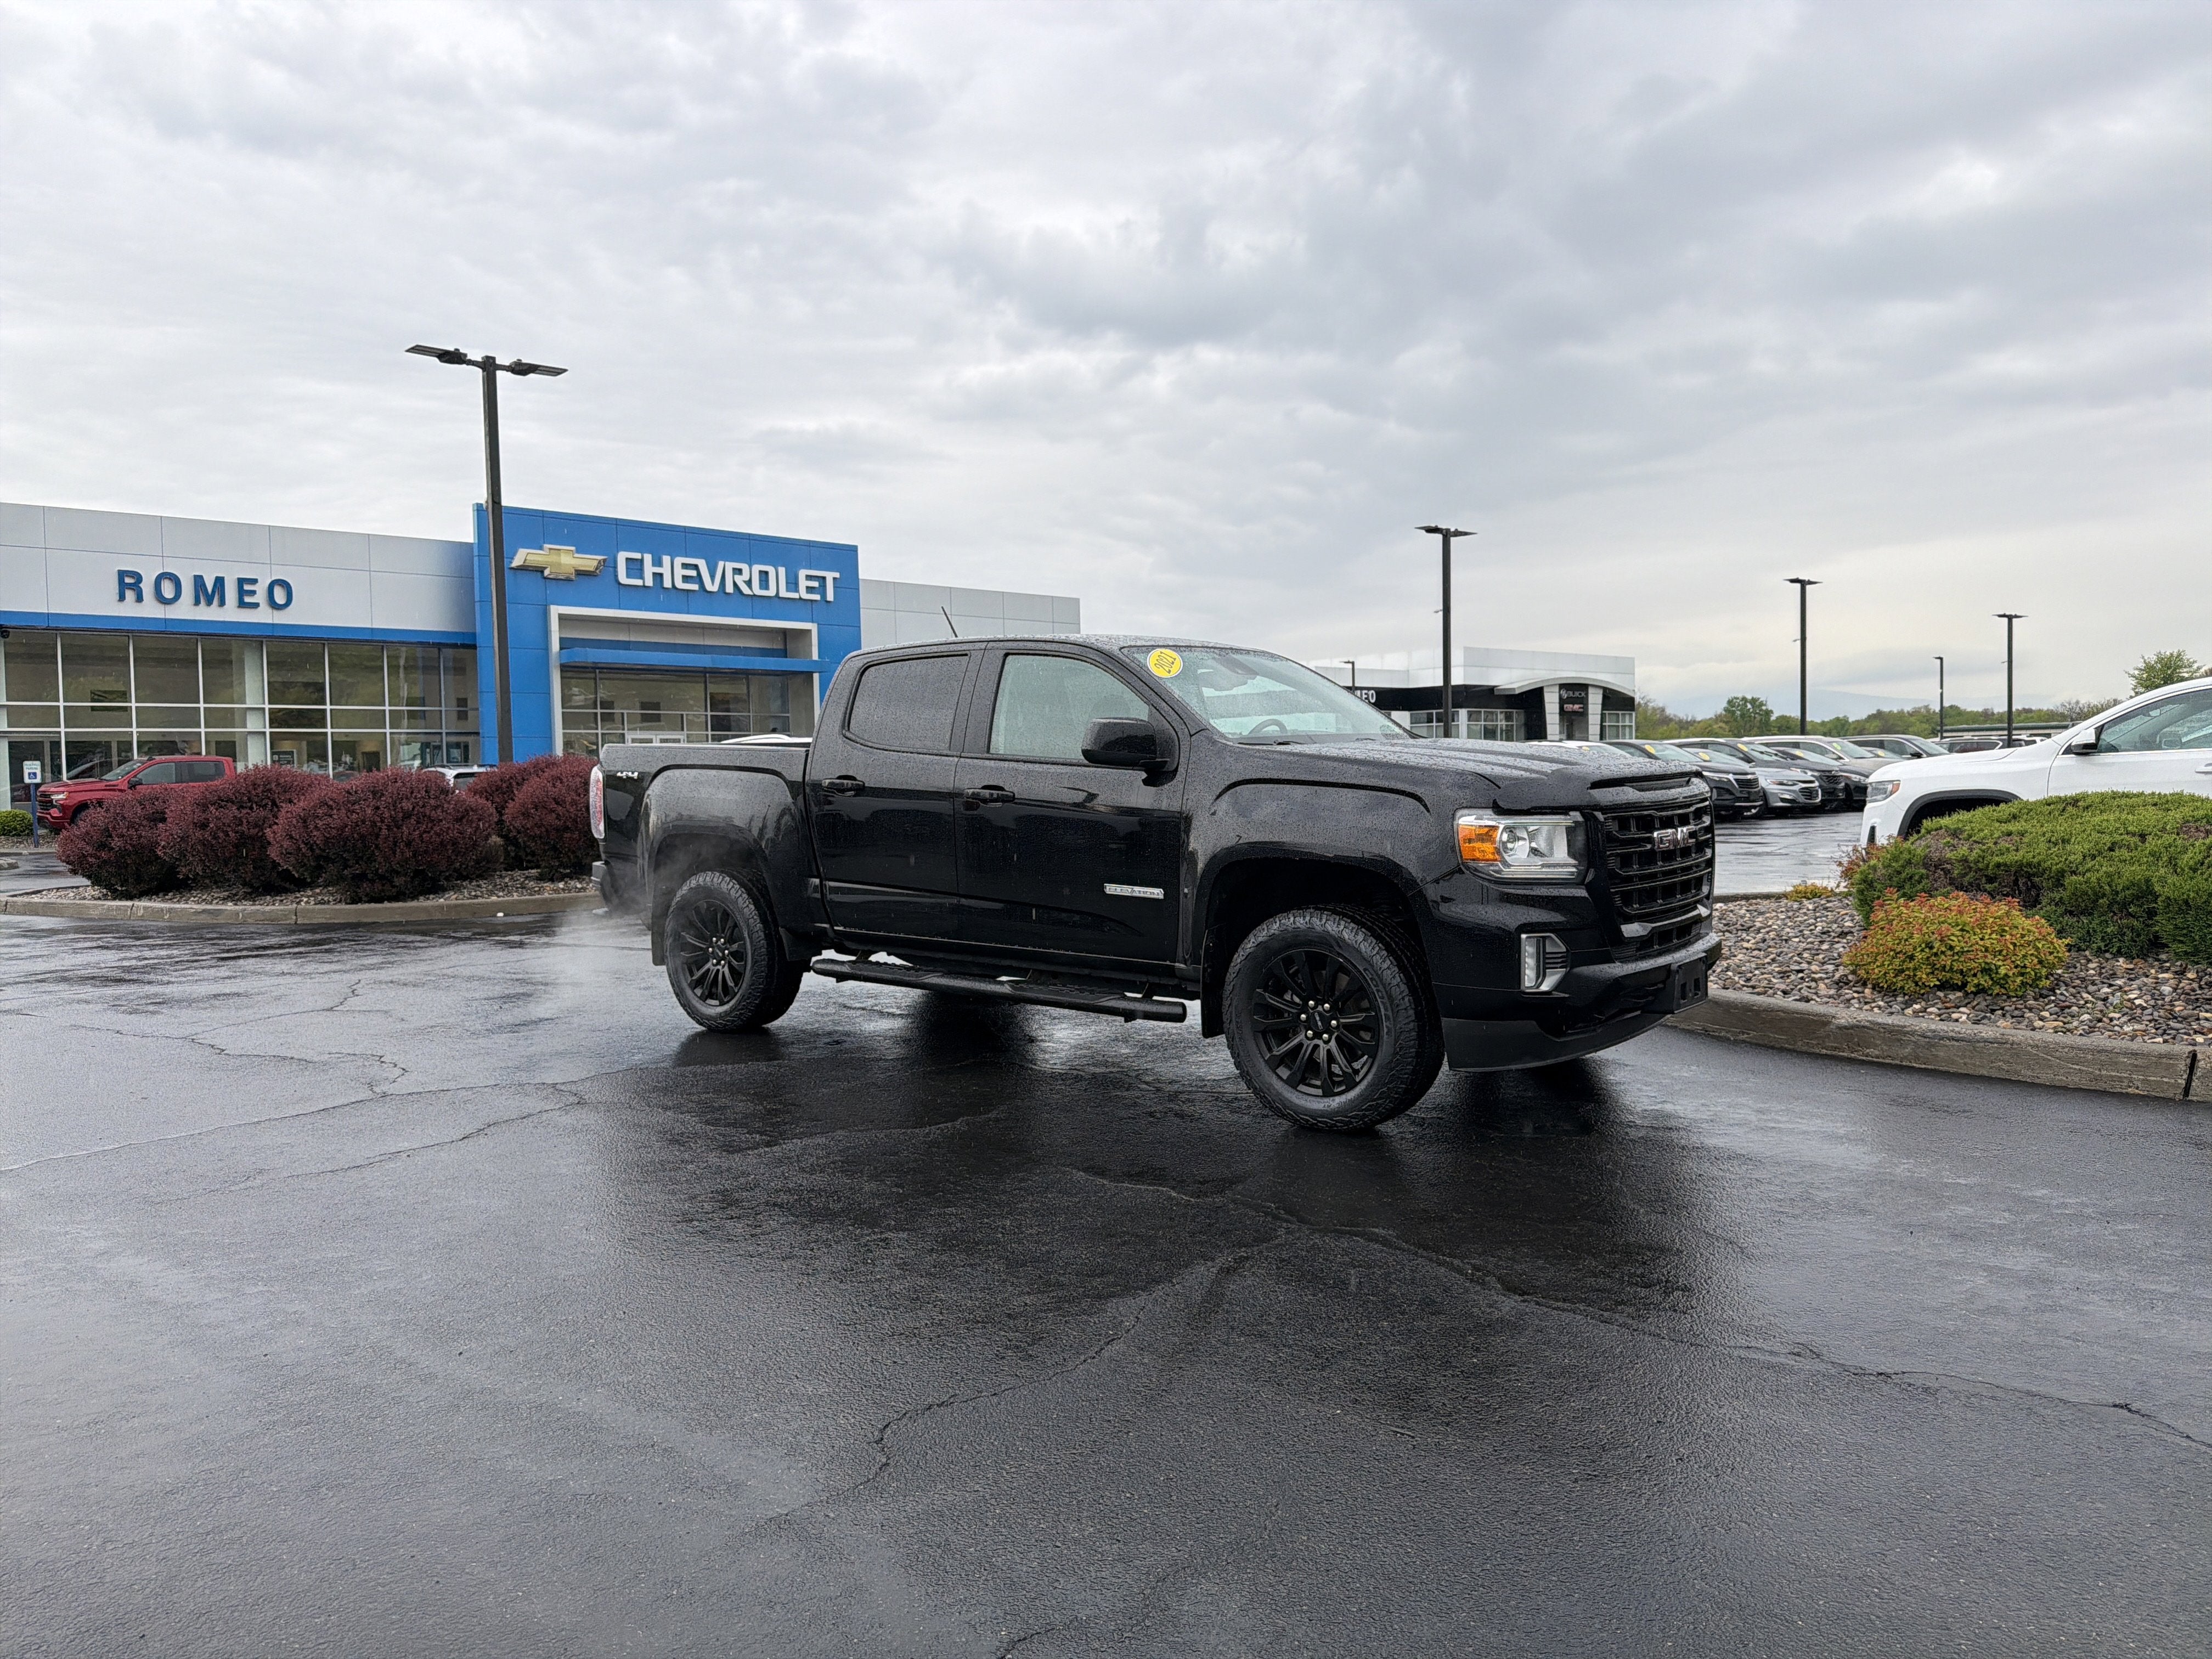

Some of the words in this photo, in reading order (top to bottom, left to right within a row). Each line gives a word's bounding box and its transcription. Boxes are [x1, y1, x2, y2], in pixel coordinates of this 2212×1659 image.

[617, 551, 840, 602] CHEVROLET
[117, 569, 294, 610] ROMEO
[1154, 651, 1176, 674] 2021
[1564, 704, 1584, 712] GMC
[1654, 826, 1697, 851] GMC
[1108, 887, 1160, 896] ELEVATION
